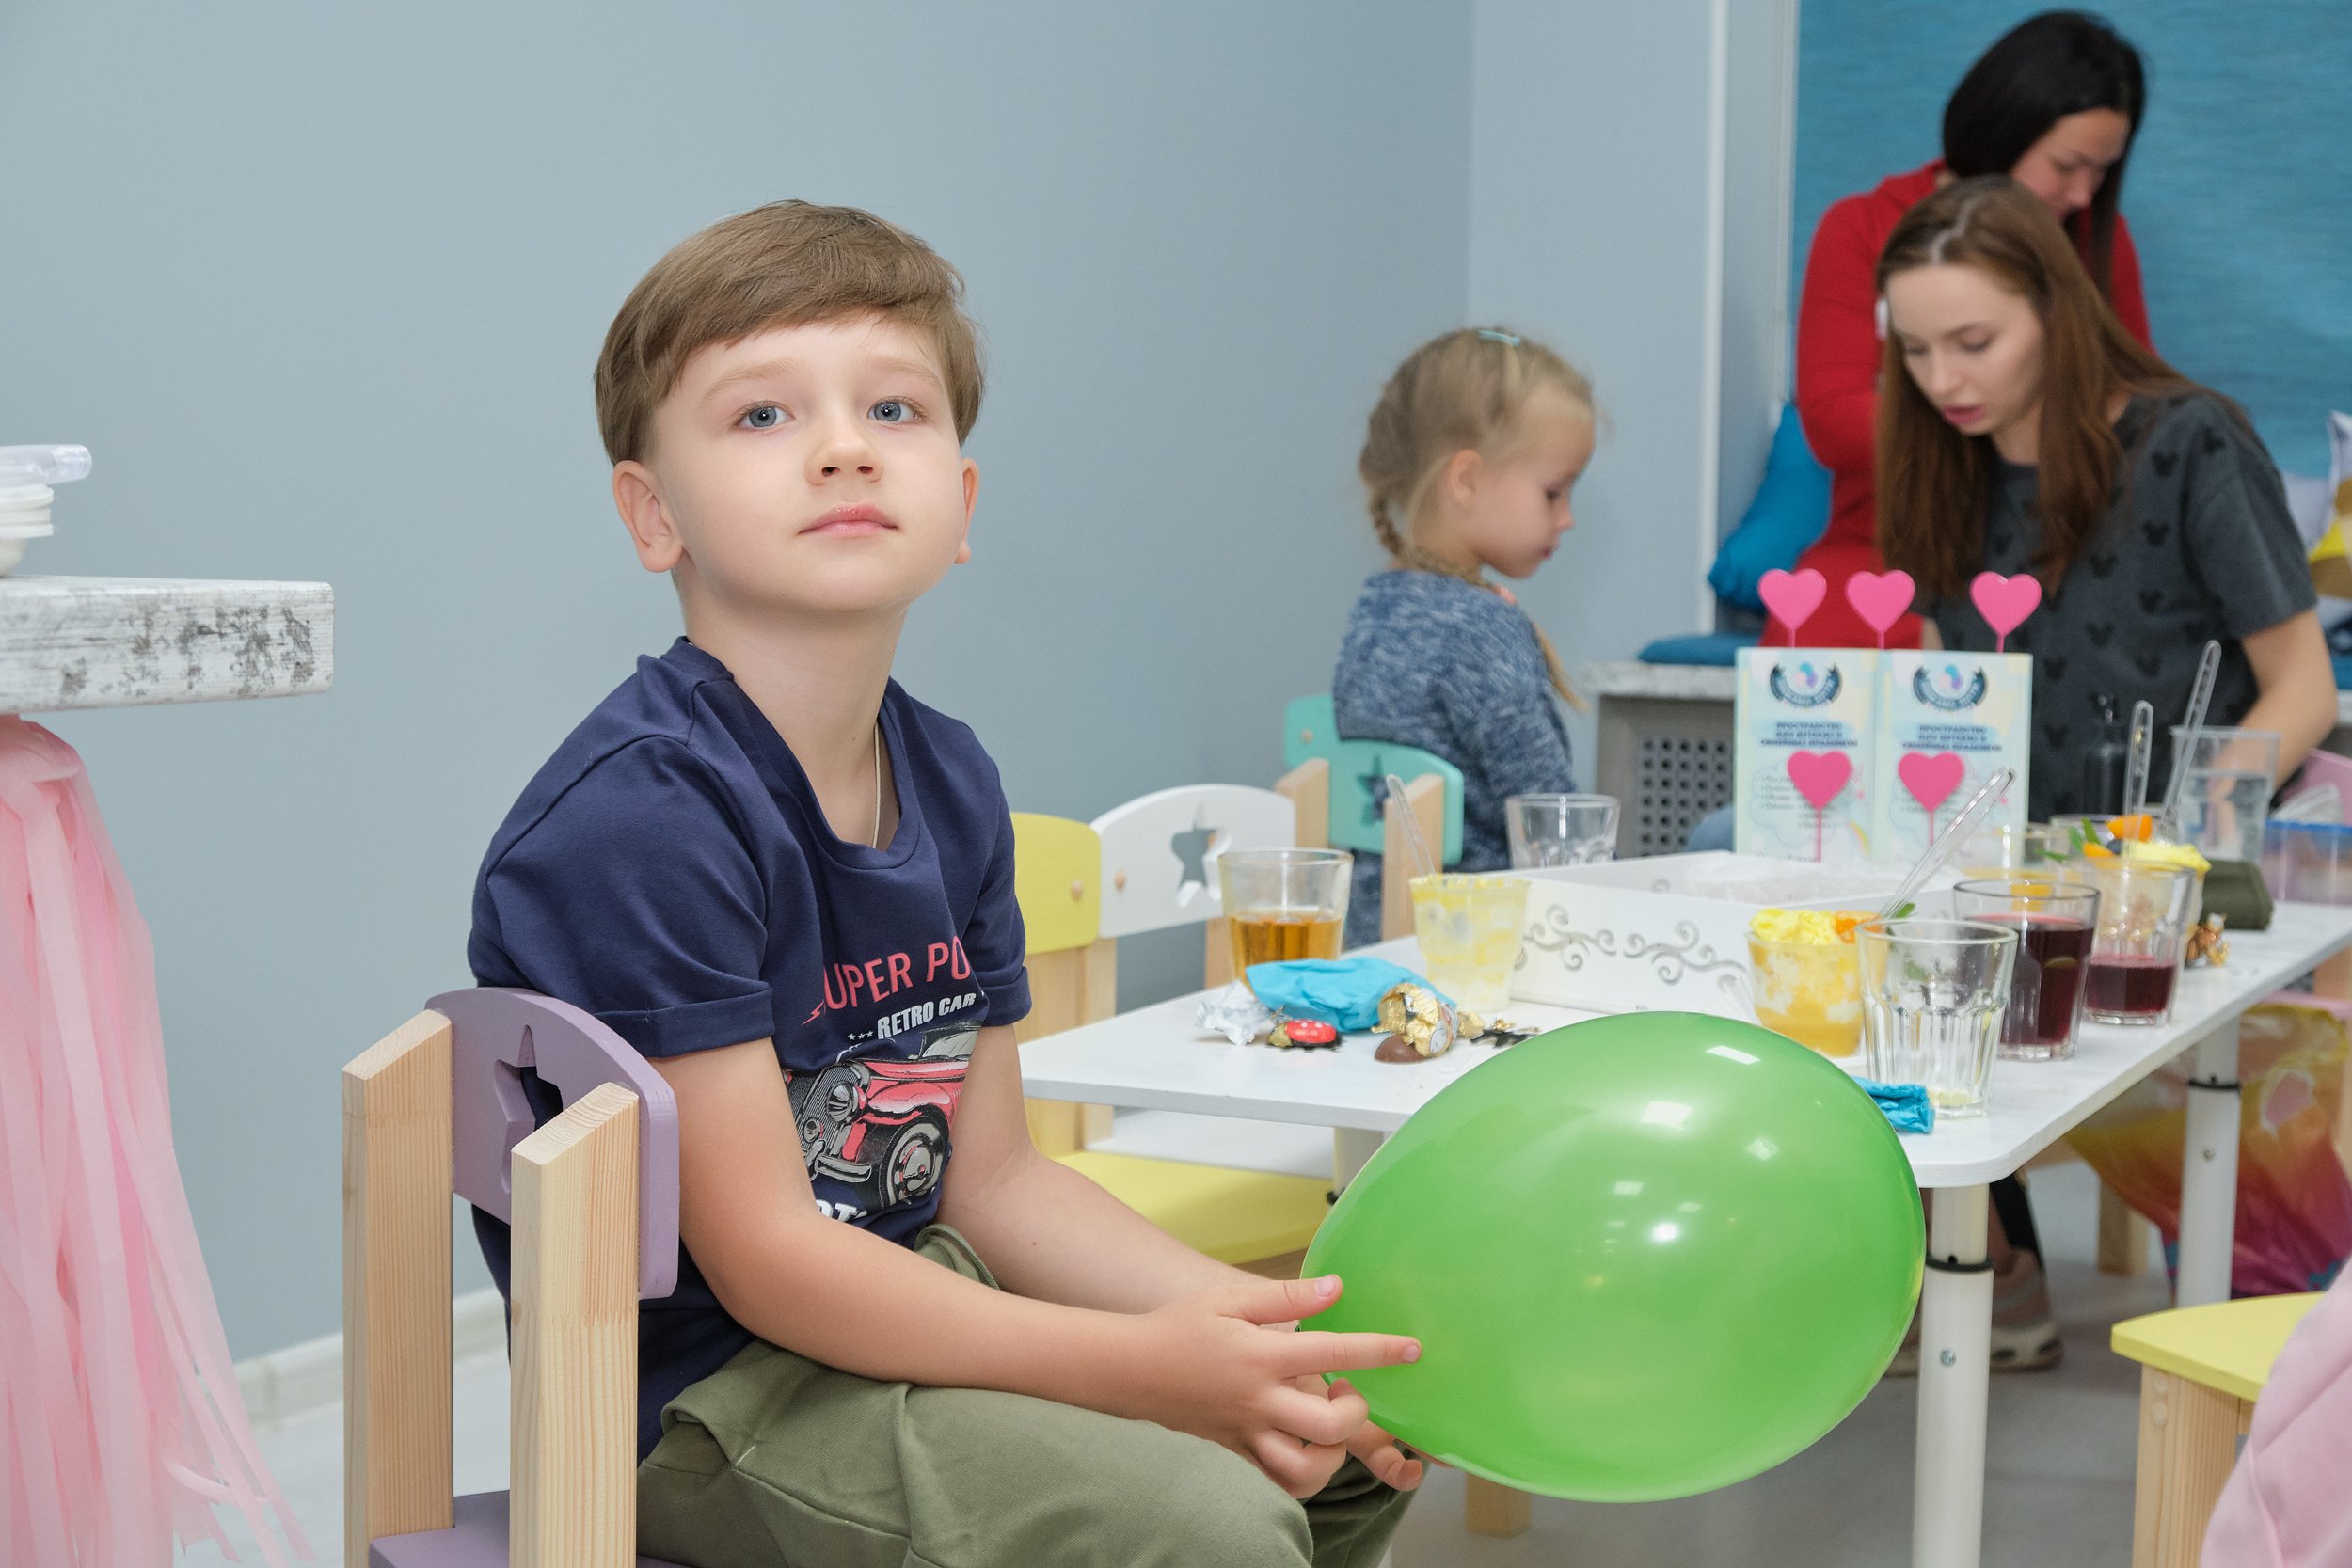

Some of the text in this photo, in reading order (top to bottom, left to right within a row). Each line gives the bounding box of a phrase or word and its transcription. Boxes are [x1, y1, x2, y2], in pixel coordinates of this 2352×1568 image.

[802, 952, 914, 1026] UPER
[877, 993, 977, 1040] RETRO CAR
